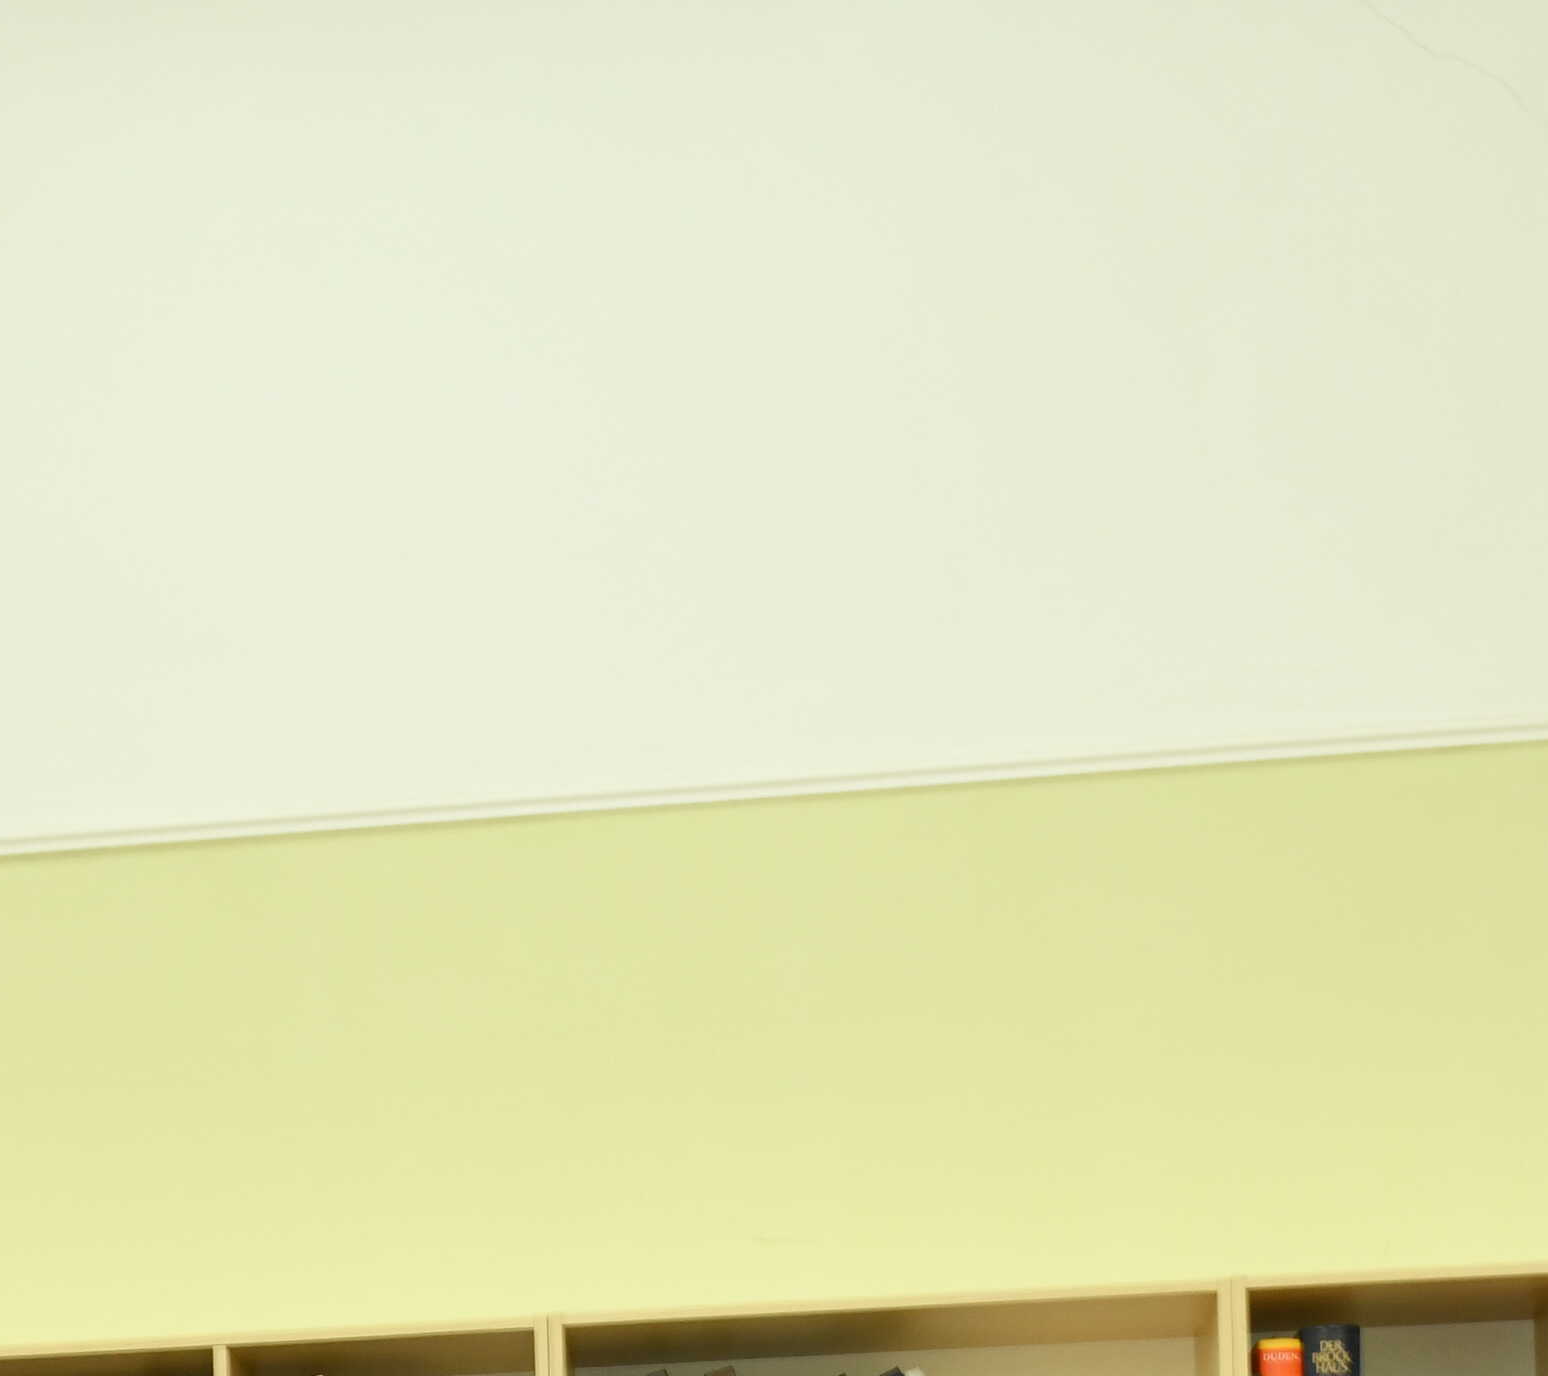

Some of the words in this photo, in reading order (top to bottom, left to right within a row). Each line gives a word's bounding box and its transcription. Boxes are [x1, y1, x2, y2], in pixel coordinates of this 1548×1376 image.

[1320, 1340, 1344, 1351] DER
[1263, 1351, 1300, 1361] DUDEN
[1312, 1351, 1352, 1363] BROCK
[1315, 1362, 1349, 1374] HAUS
